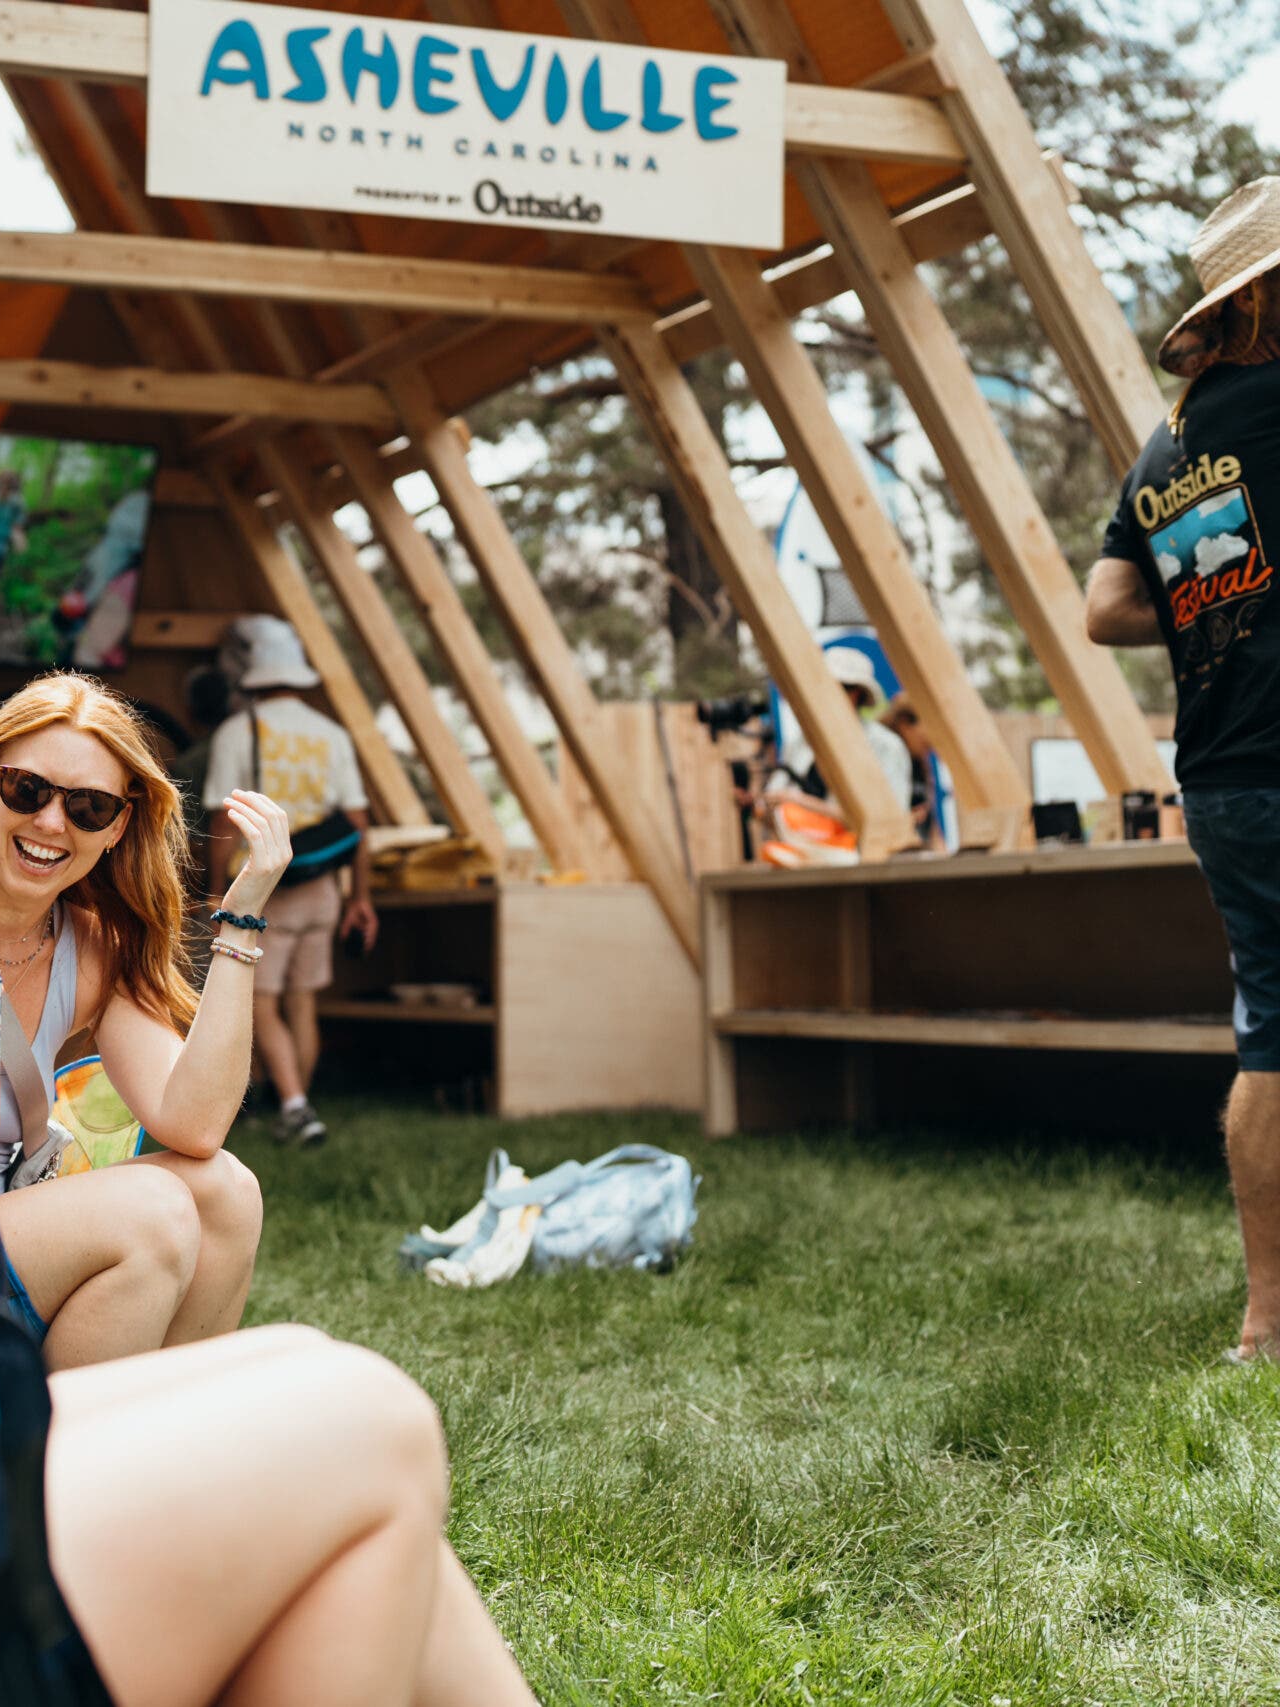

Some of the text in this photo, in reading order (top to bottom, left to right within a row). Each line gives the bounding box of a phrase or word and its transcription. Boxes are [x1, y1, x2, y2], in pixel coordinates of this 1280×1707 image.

[200, 19, 740, 141] ASHEVILLE
[287, 122, 660, 172] NORTH CAROLINA
[473, 178, 603, 224] Outside
[1134, 453, 1242, 529] Outside
